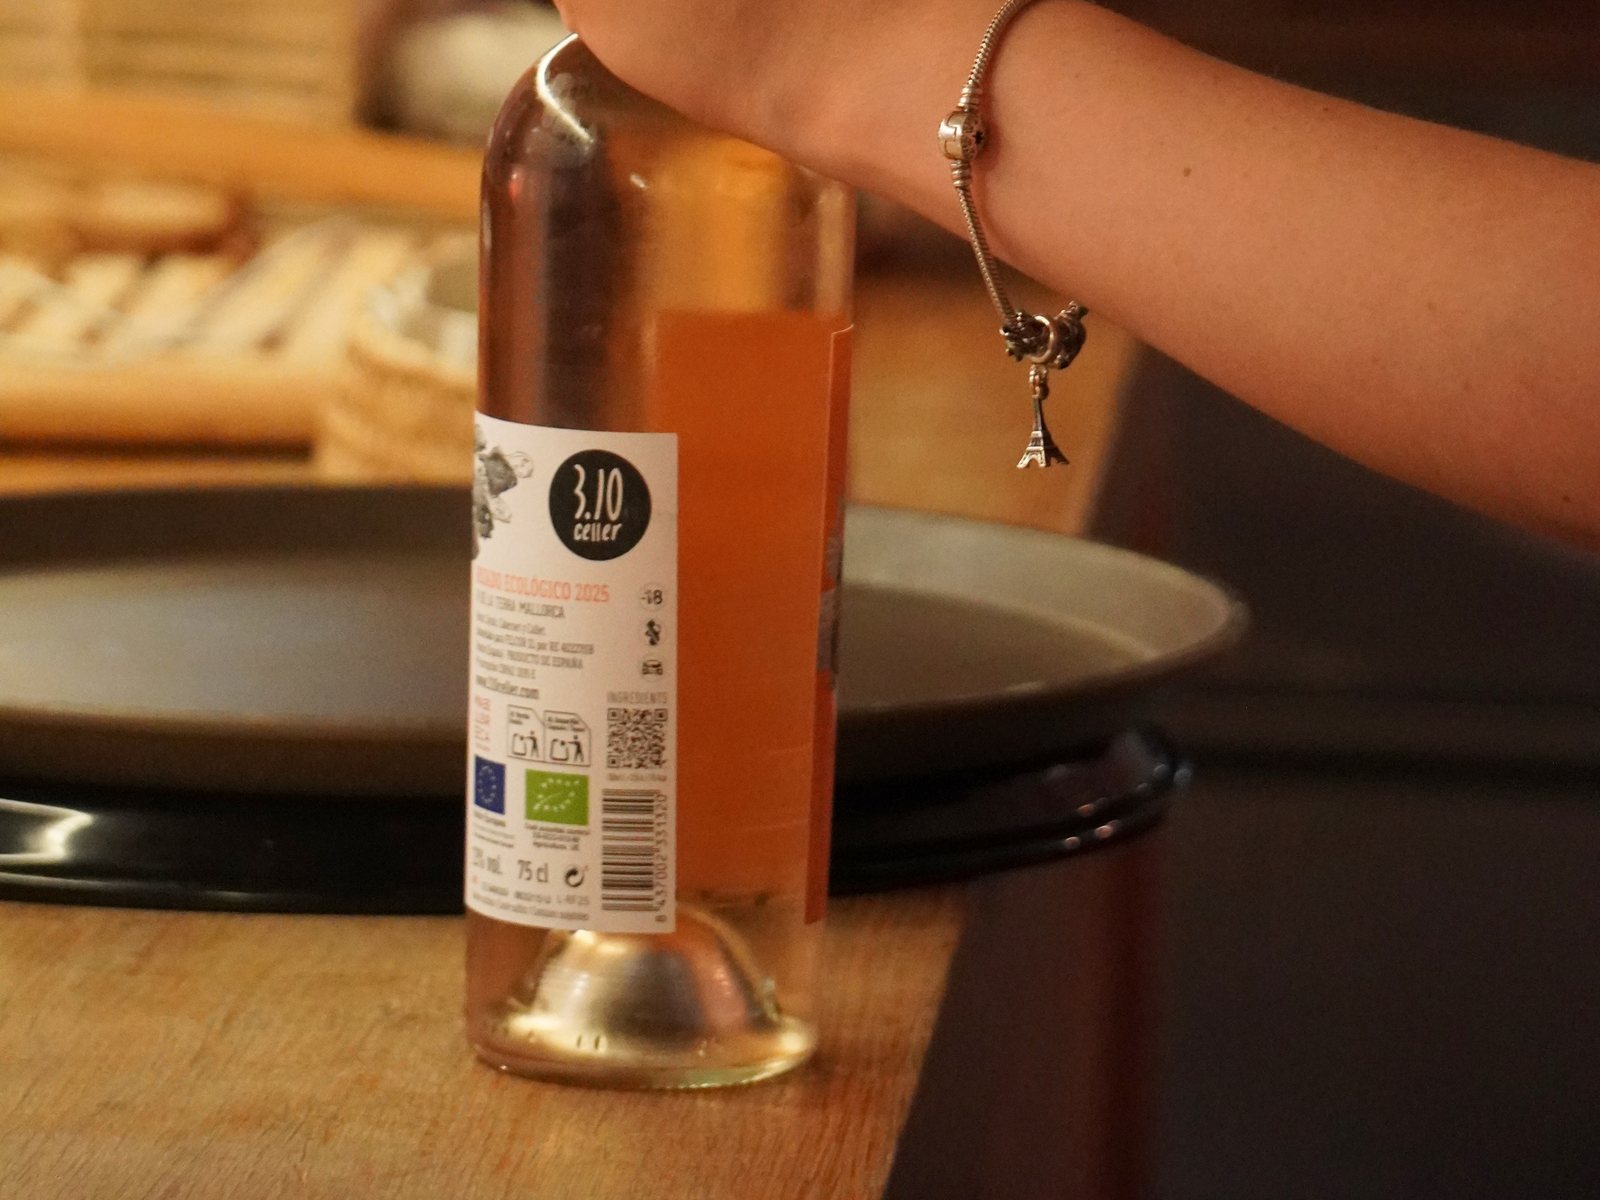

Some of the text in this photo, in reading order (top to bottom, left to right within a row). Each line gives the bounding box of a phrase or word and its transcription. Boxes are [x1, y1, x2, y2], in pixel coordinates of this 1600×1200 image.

[573, 463, 624, 522] 3.10
[573, 522, 623, 542] celler
[574, 582, 611, 604] 2025
[517, 859, 549, 884] 75 cl
